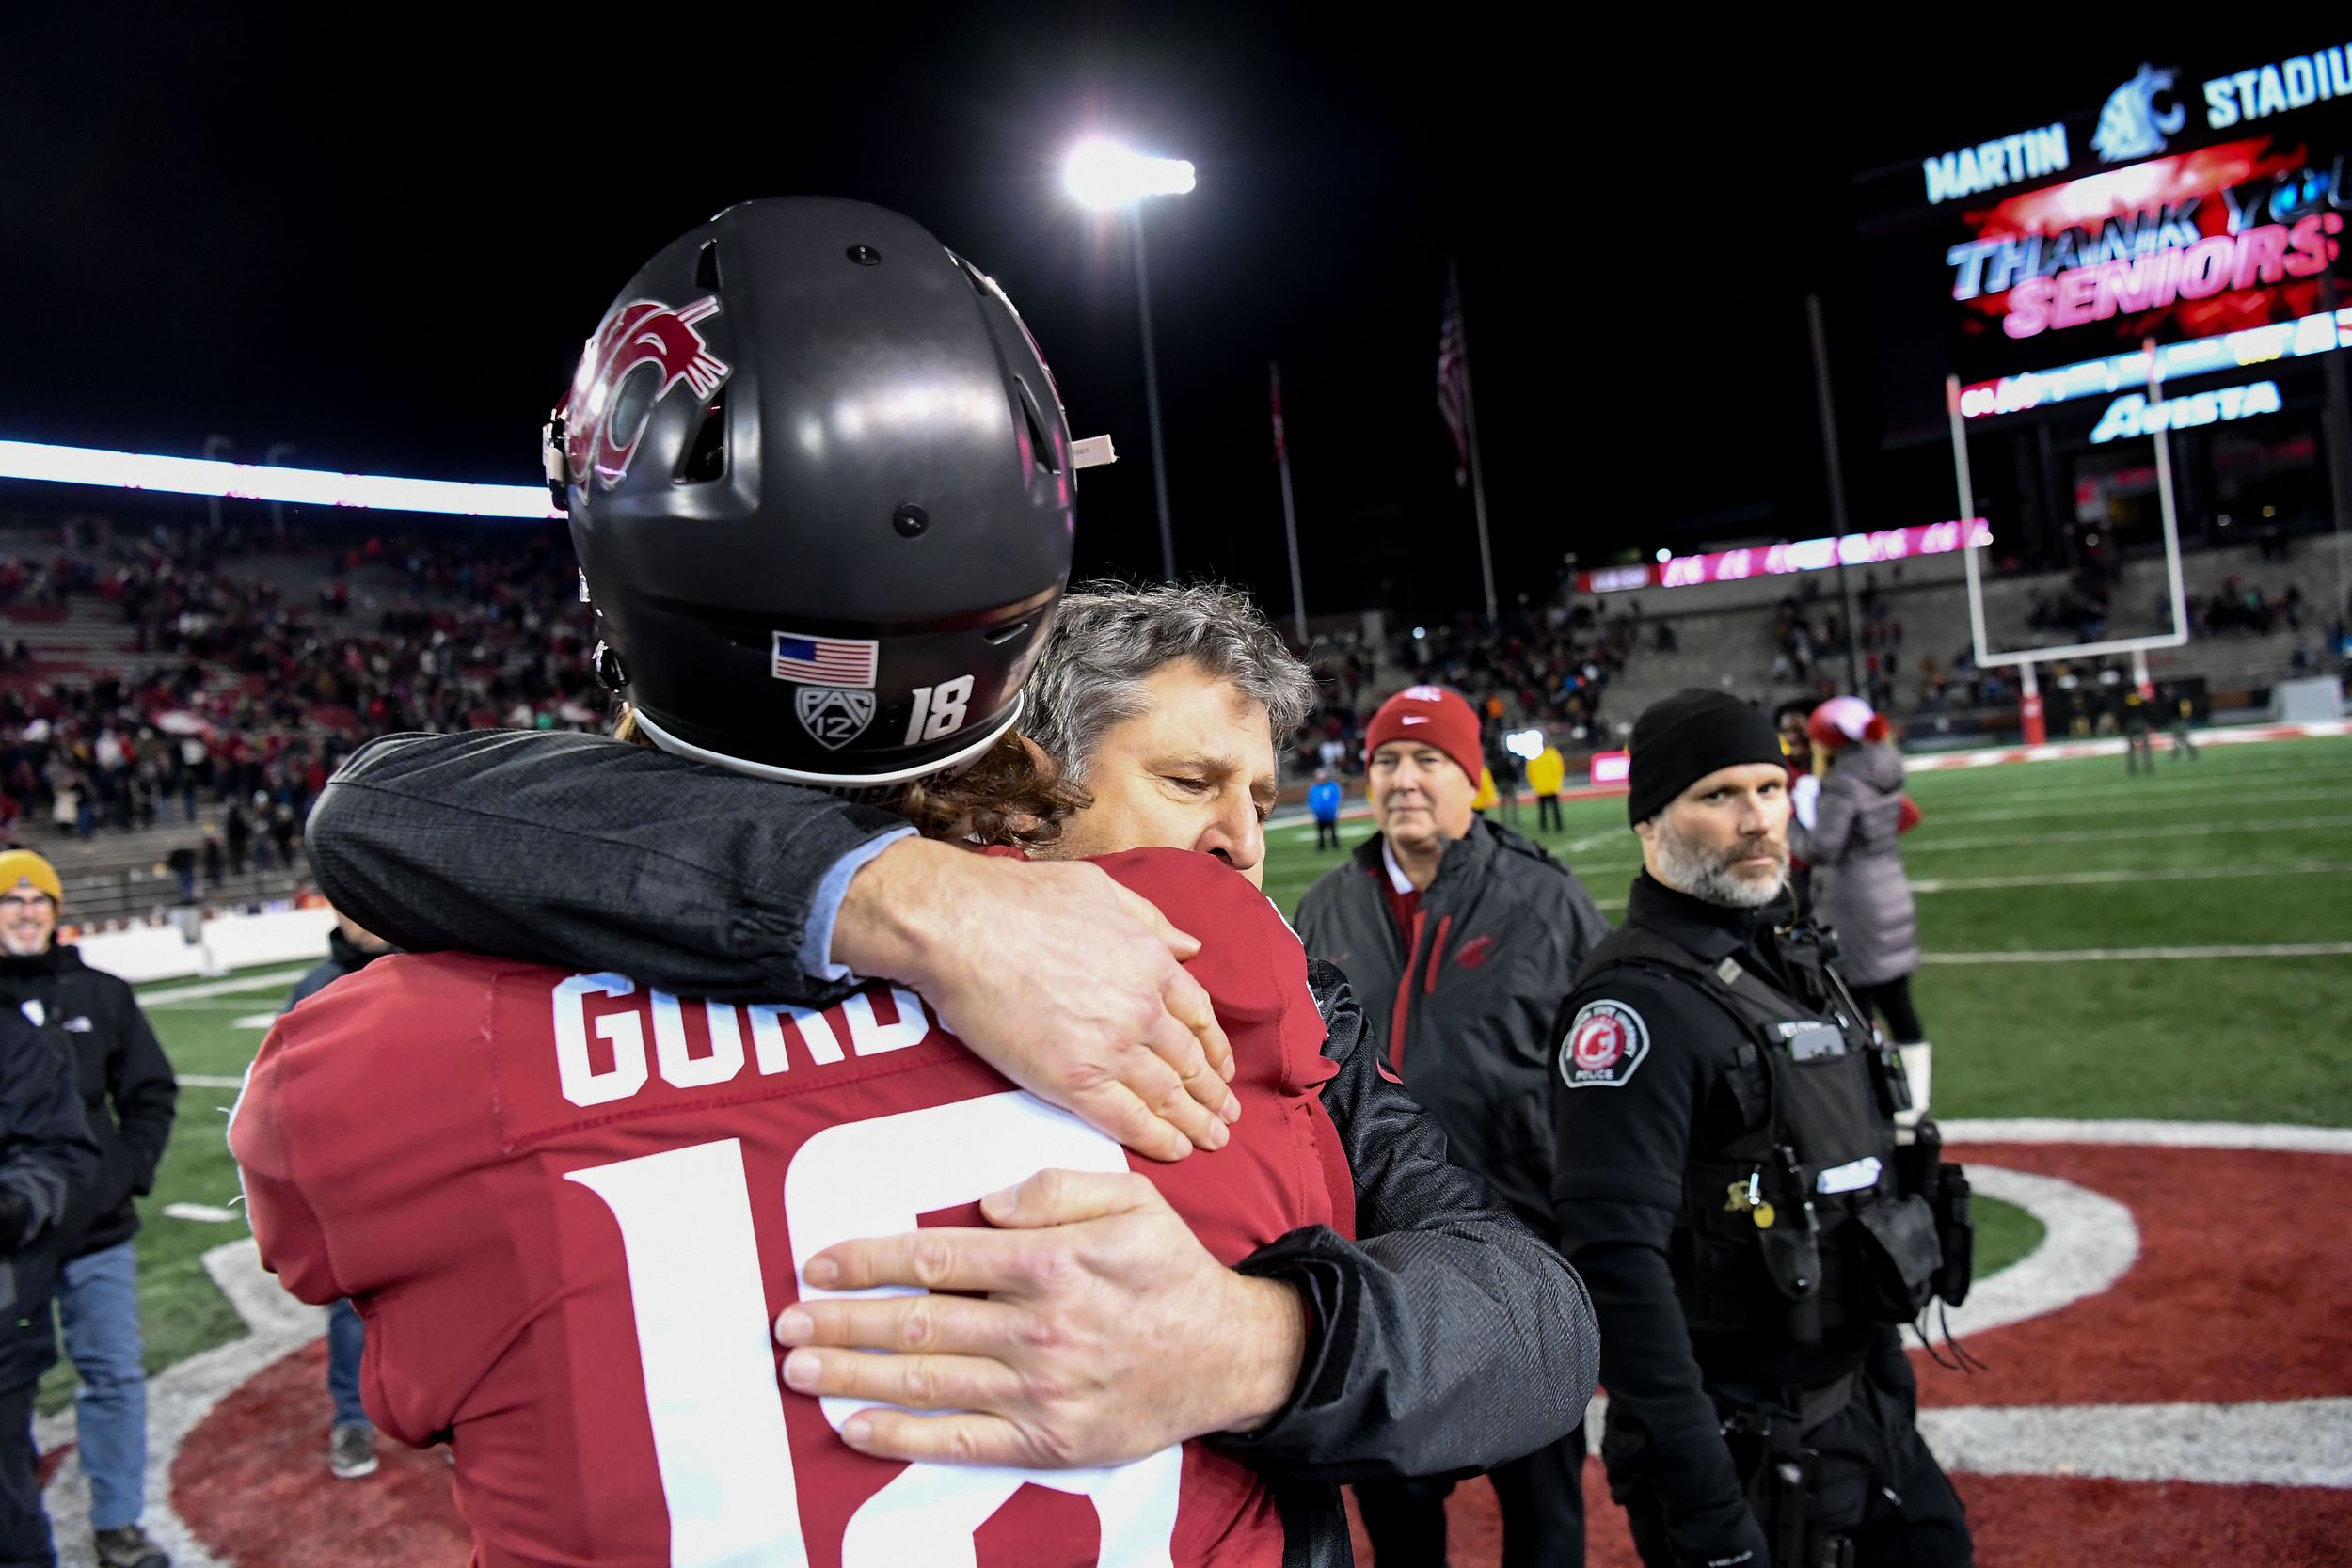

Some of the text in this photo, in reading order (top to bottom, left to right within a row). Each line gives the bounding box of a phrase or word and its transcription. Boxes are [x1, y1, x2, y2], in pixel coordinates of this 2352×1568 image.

[1922, 122, 2069, 205] MARTIN
[1946, 195, 2205, 301] THANK
[803, 689, 872, 727] PAC
[815, 716, 852, 738] 12
[904, 673, 975, 746] 18
[552, 971, 952, 1107] GORD
[1575, 1068, 1614, 1081] POLICE
